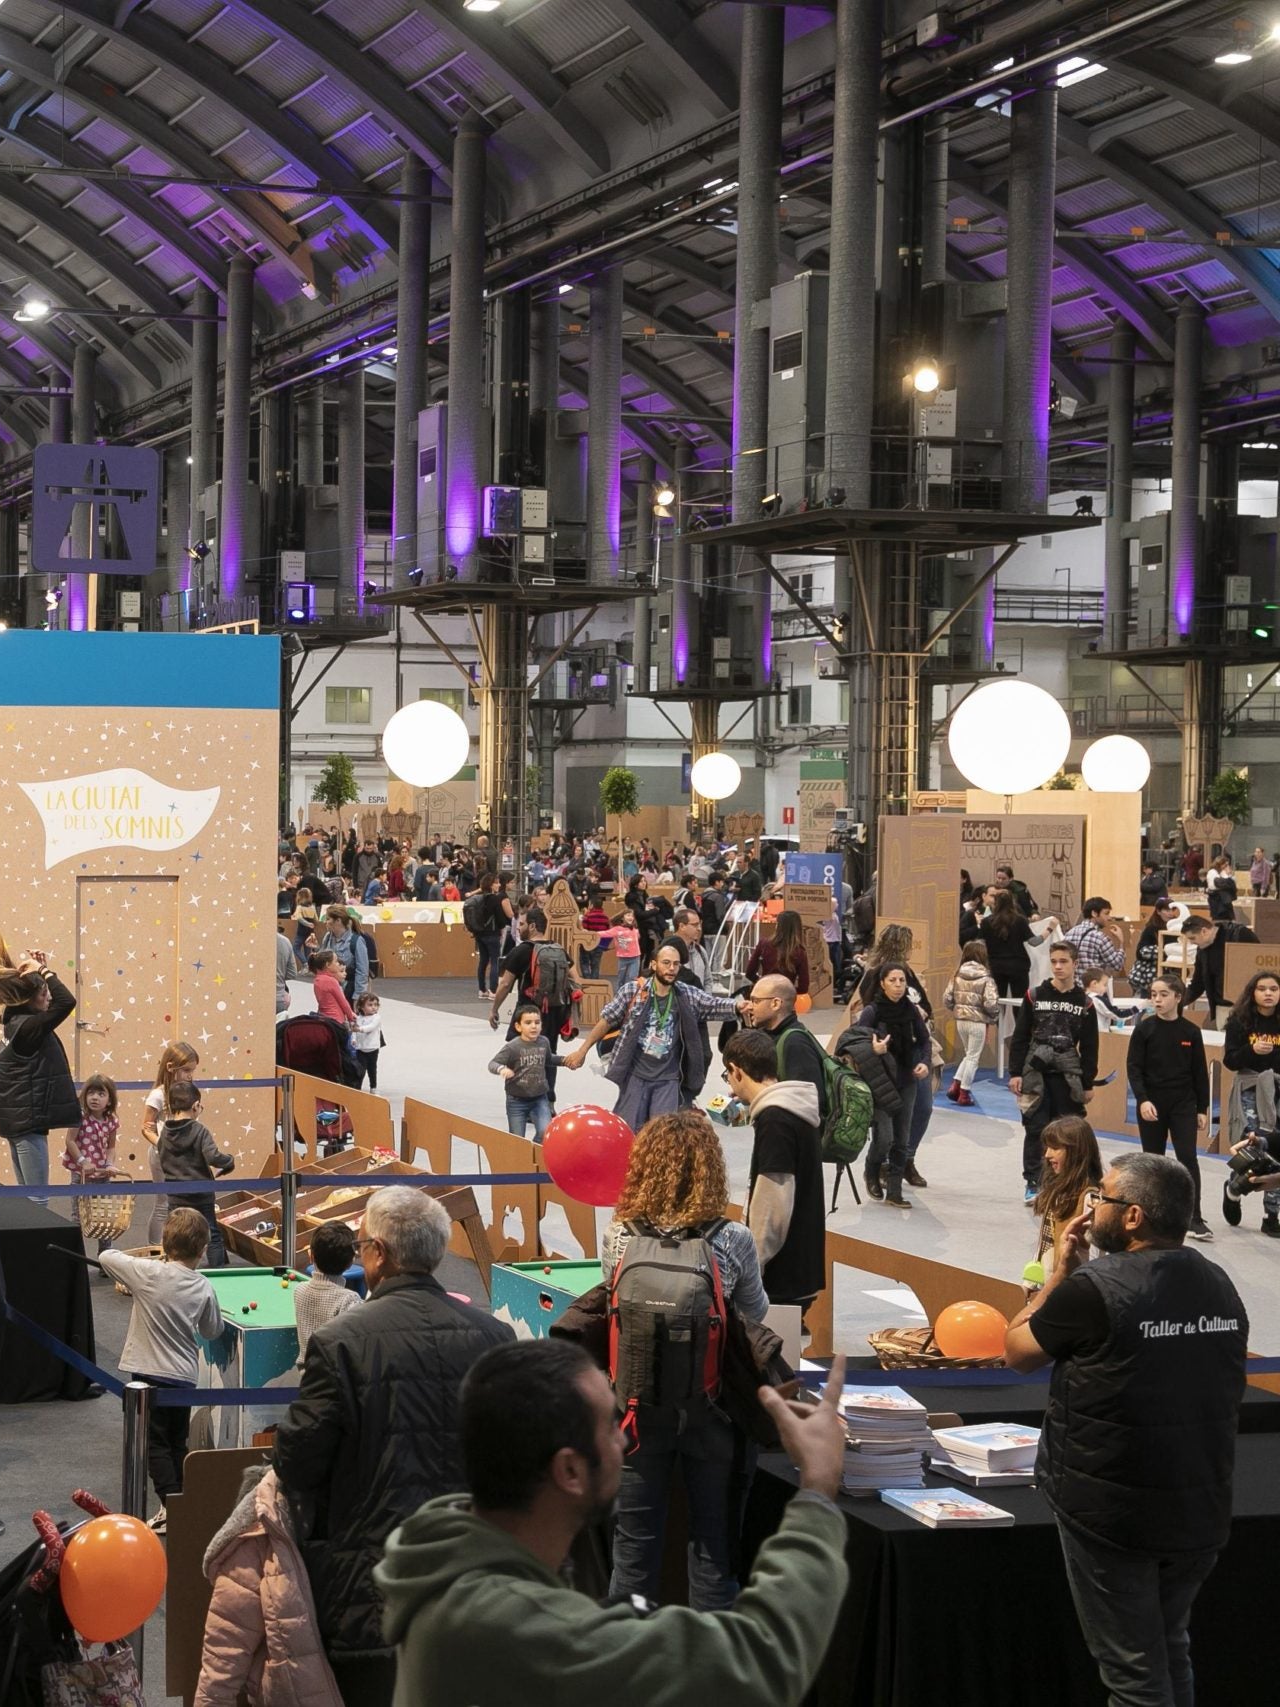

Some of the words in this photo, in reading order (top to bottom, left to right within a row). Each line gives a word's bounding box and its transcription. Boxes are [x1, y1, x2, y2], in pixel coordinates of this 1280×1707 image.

[45, 790, 67, 810] LA
[72, 785, 144, 811] CIUTAT
[64, 815, 97, 830] DELS
[104, 815, 185, 839] SOMNIS
[1256, 955, 1280, 967] ORI
[1139, 1320, 1183, 1338] Taller
[1184, 1322, 1196, 1335] de
[1198, 1316, 1239, 1333] Cultura
